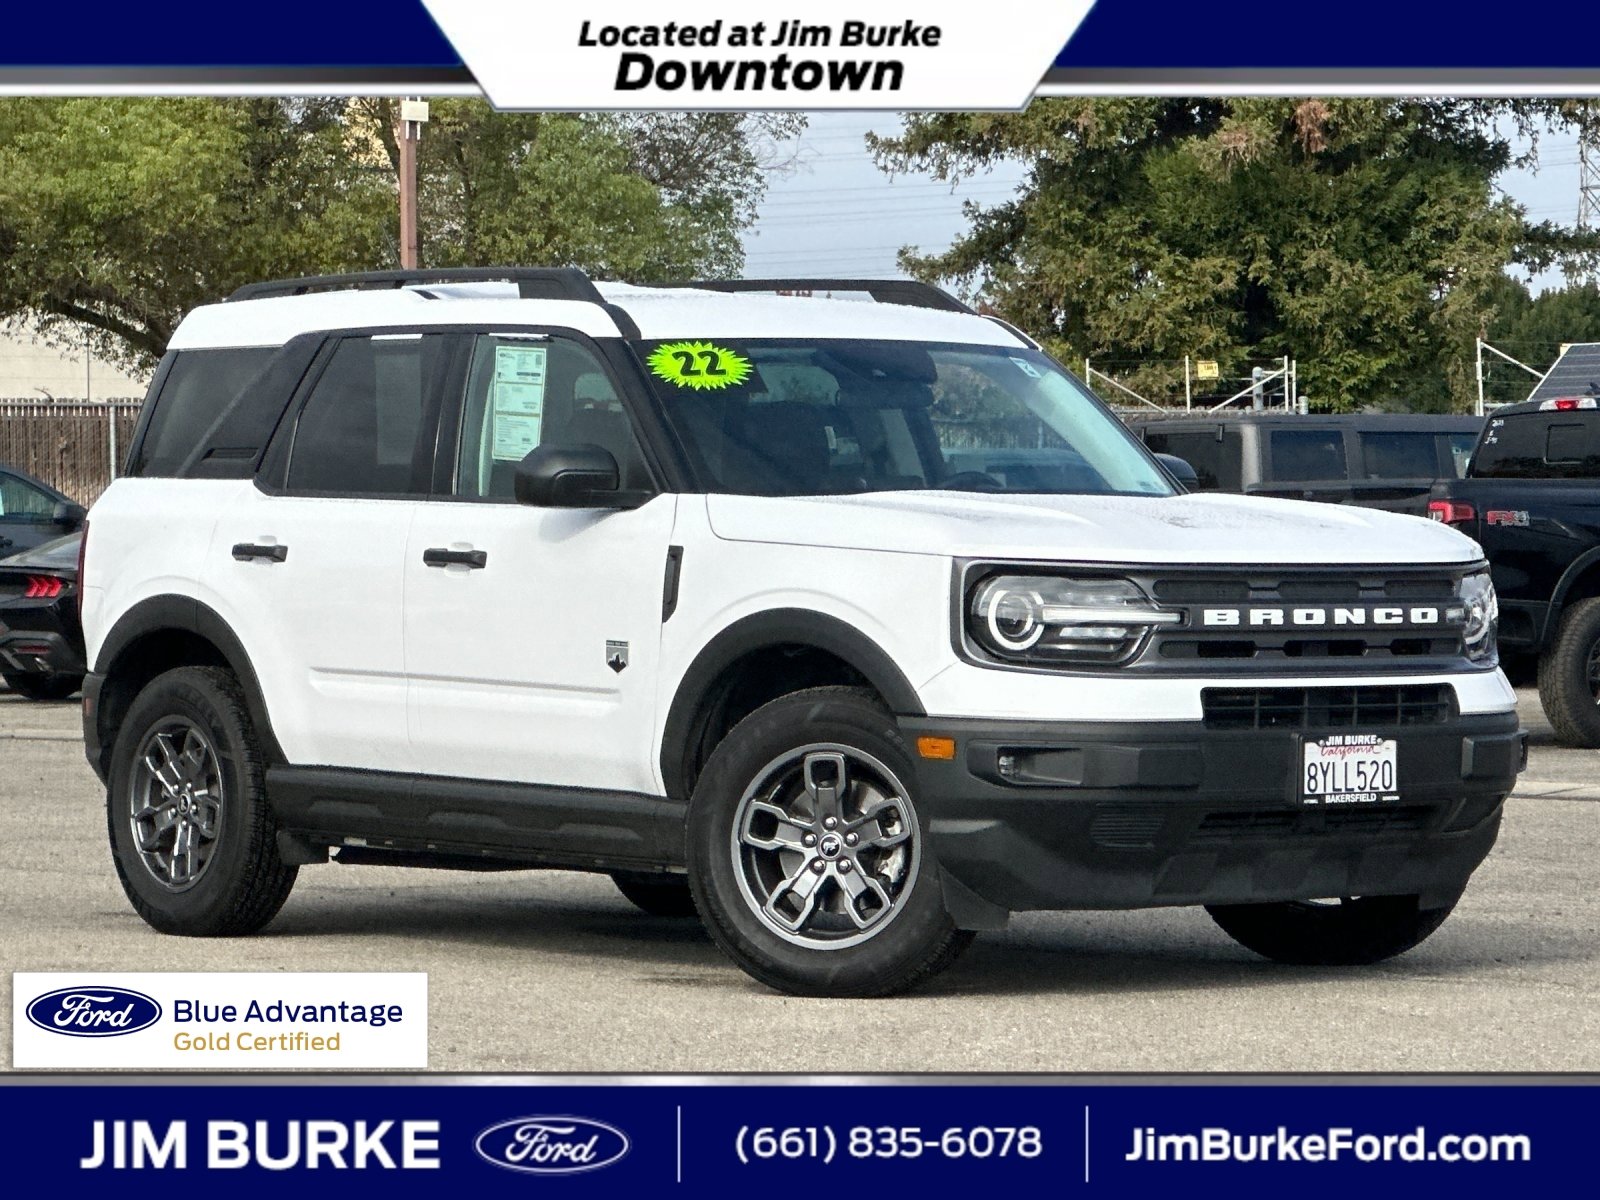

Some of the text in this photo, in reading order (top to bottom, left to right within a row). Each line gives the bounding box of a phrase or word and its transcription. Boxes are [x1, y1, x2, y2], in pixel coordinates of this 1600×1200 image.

[672, 351, 727, 377] 22
[1203, 607, 1439, 626] BRONCO
[1326, 735, 1377, 746] JIM BURKE
[1320, 745, 1382, 760] California
[1307, 760, 1393, 793] 8YLL520
[1325, 793, 1377, 804] BAKERSFIELD
